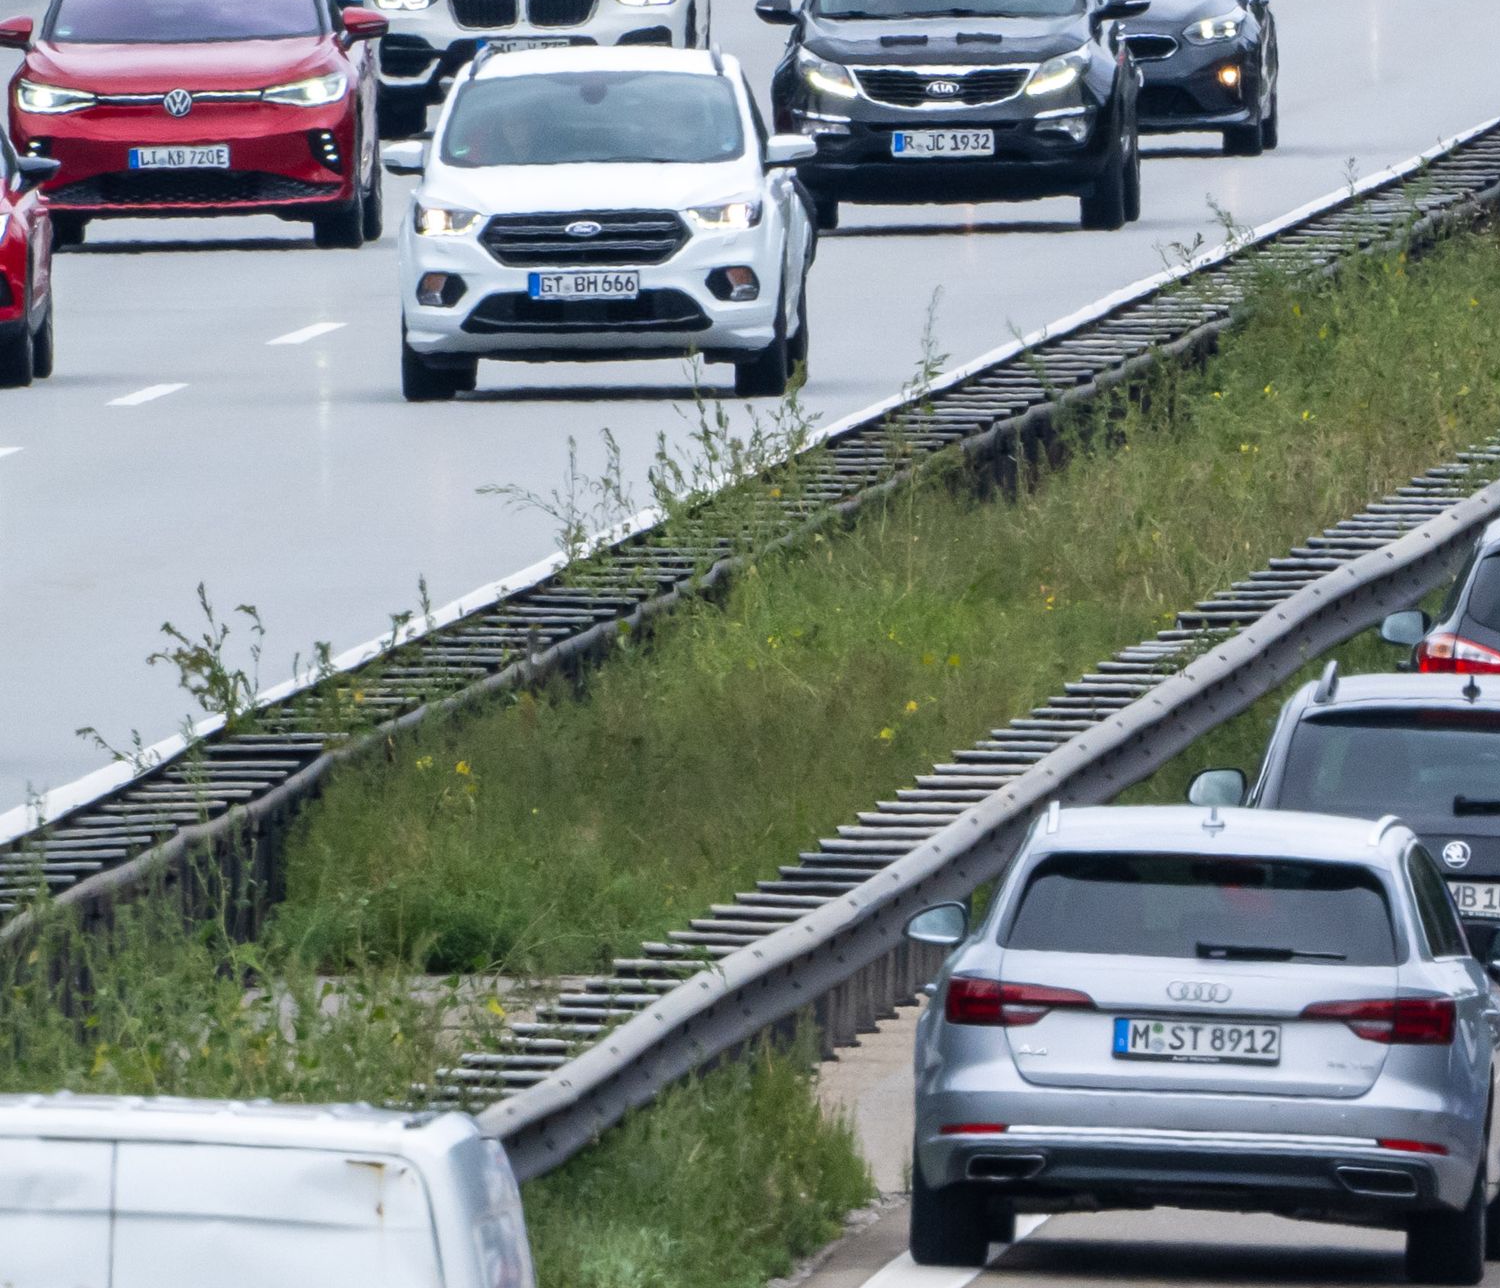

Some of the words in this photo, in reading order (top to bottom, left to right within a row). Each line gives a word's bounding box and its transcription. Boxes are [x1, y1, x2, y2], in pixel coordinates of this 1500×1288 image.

[904, 135, 916, 151] R
[924, 134, 948, 151] JC
[950, 132, 993, 152] 1932
[541, 276, 565, 294] GT
[575, 274, 600, 293] BH
[602, 272, 637, 293] 666
[1131, 1028, 1151, 1049] M
[1169, 1030, 1201, 1051] ST
[1210, 1031, 1278, 1055] 8912
